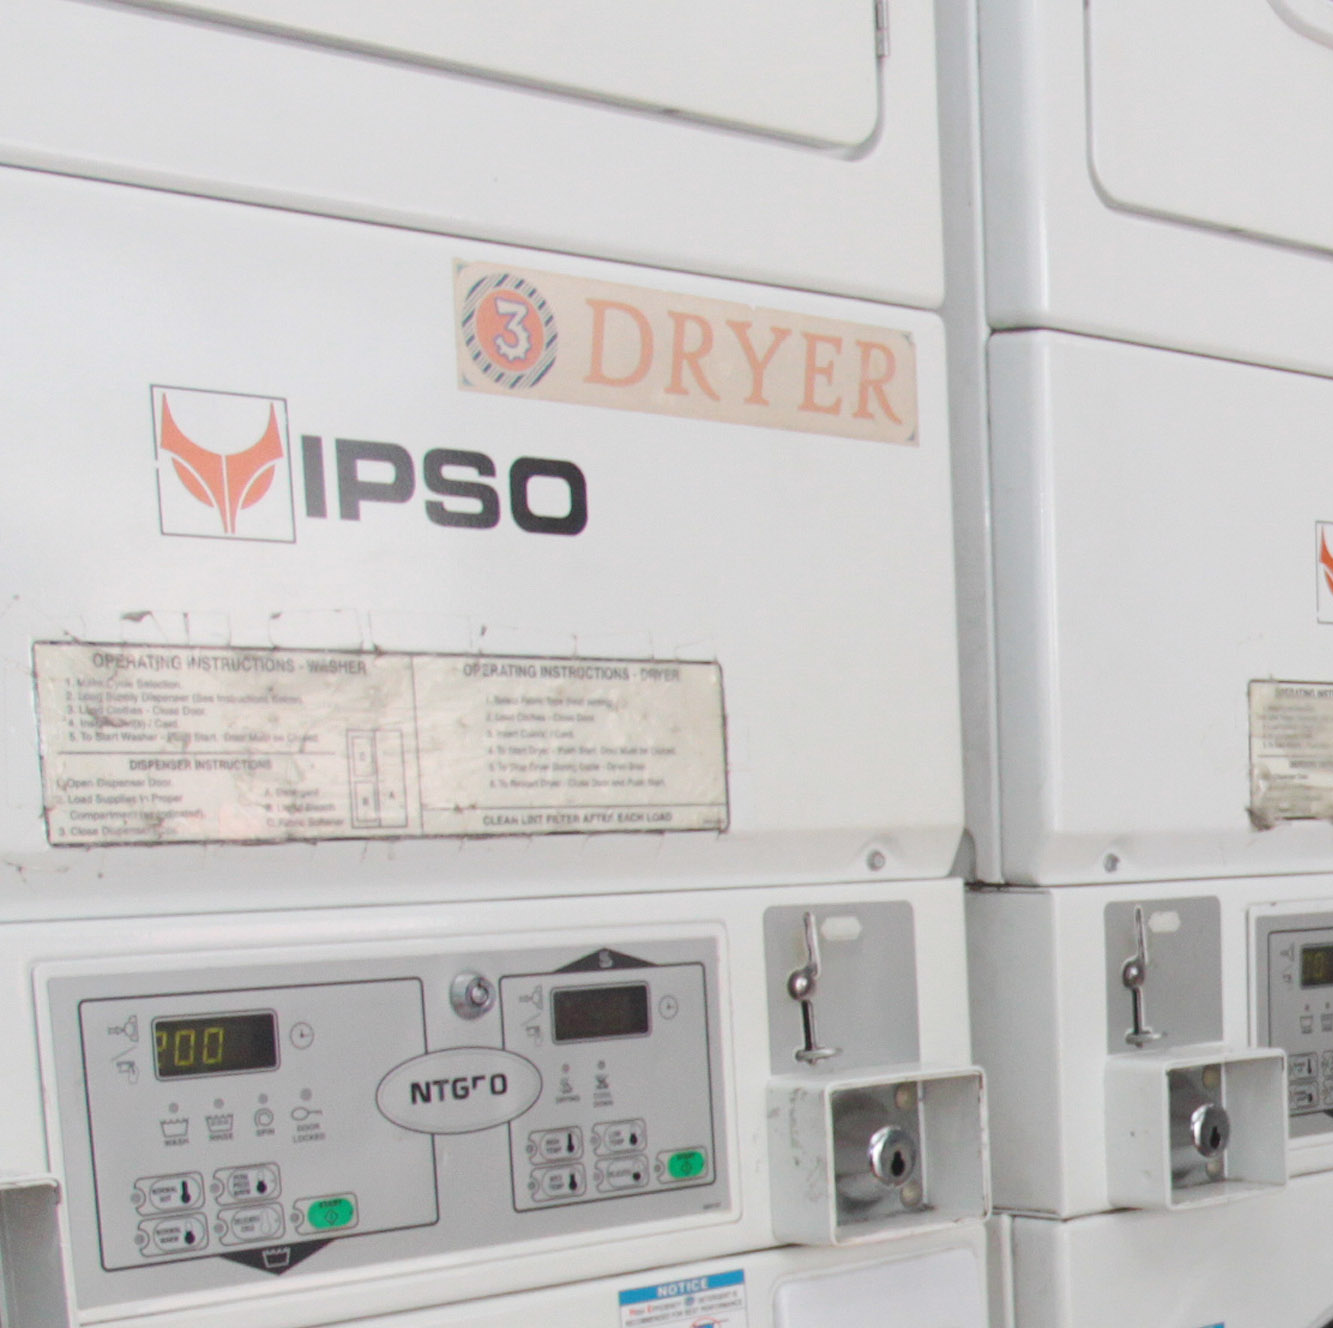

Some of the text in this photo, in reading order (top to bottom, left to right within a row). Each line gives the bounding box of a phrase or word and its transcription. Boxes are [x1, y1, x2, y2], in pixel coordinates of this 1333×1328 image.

[492, 295, 905, 427] 3 DRYER
[300, 434, 588, 537] IPSO
[92, 653, 182, 671] OPERATING
[186, 656, 295, 674] INSTRUCTIONS
[463, 664, 537, 678] OPERATING
[541, 666, 630, 680] INSTRUCTIONS
[657, 1279, 709, 1297] NOTICE
